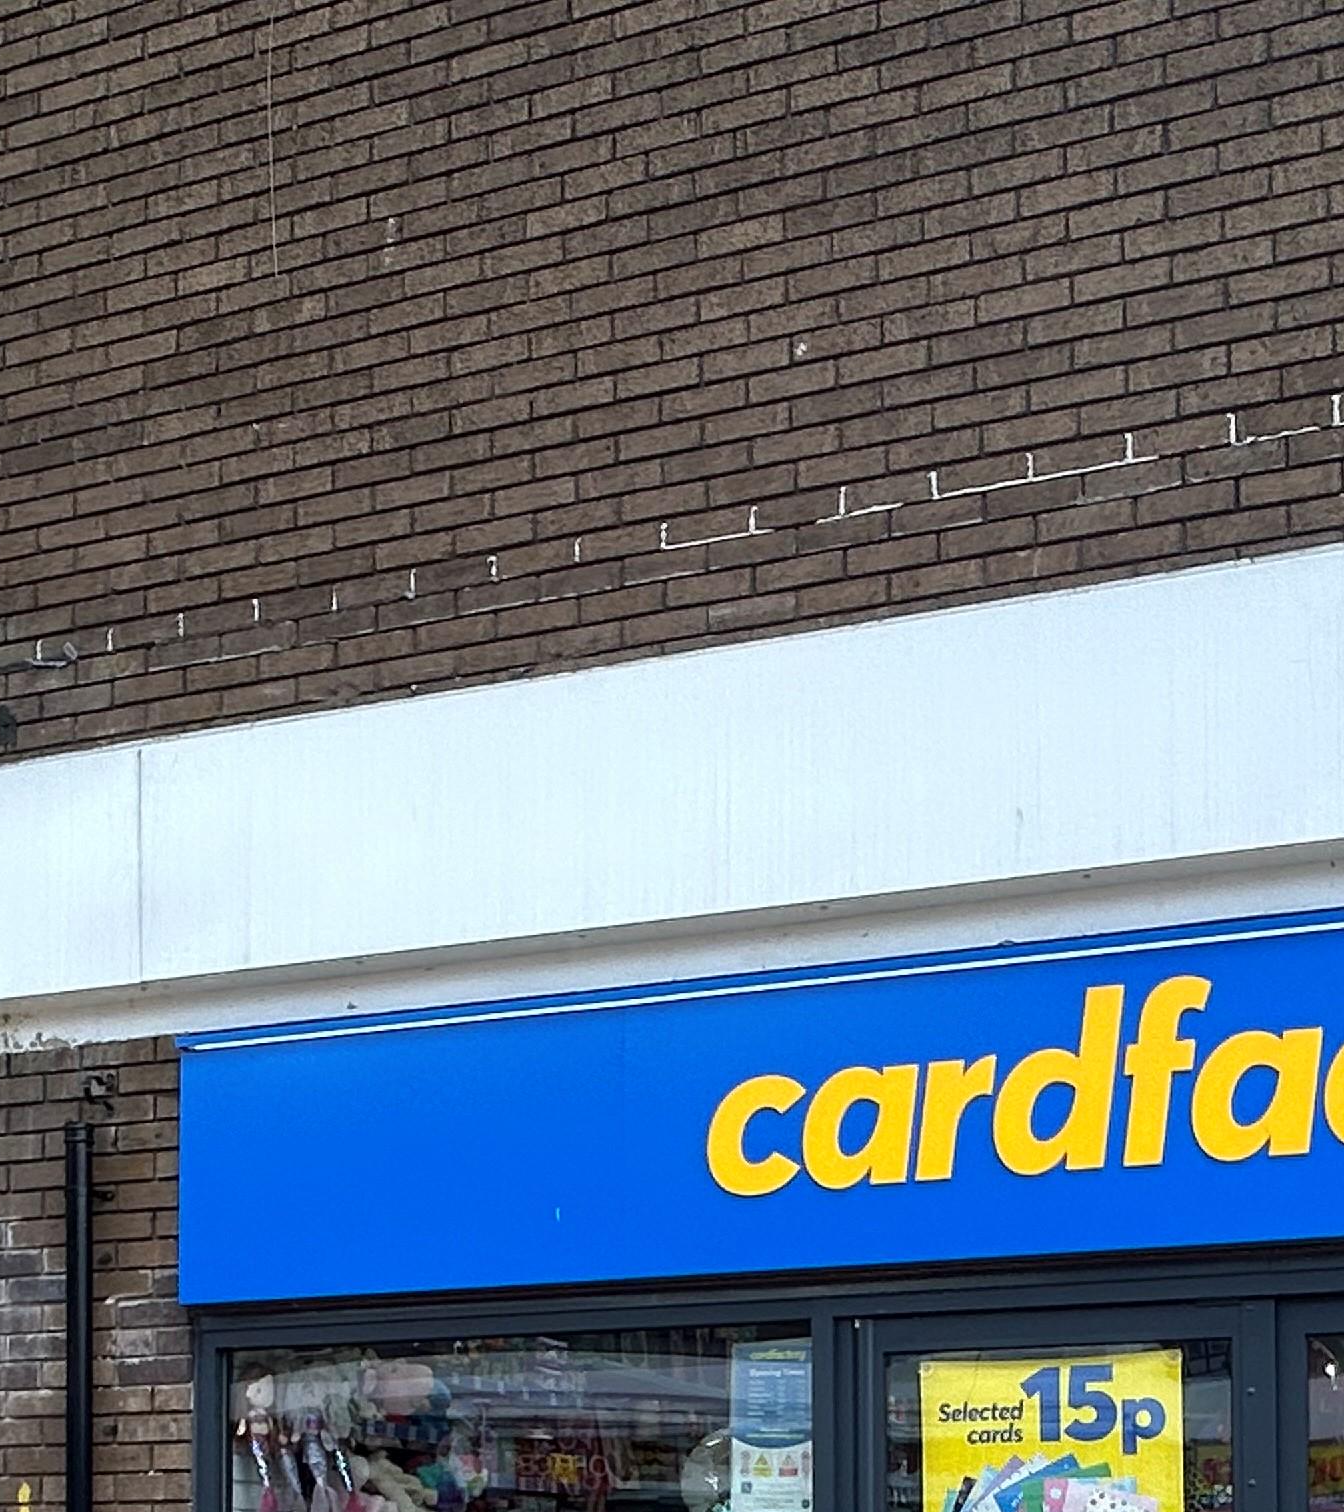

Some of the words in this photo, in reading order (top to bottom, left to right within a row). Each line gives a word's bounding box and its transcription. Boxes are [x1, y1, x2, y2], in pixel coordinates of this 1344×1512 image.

[937, 1399, 1024, 1423] Selected
[1020, 1363, 1167, 1456] 15p
[966, 1423, 1024, 1445] cards
